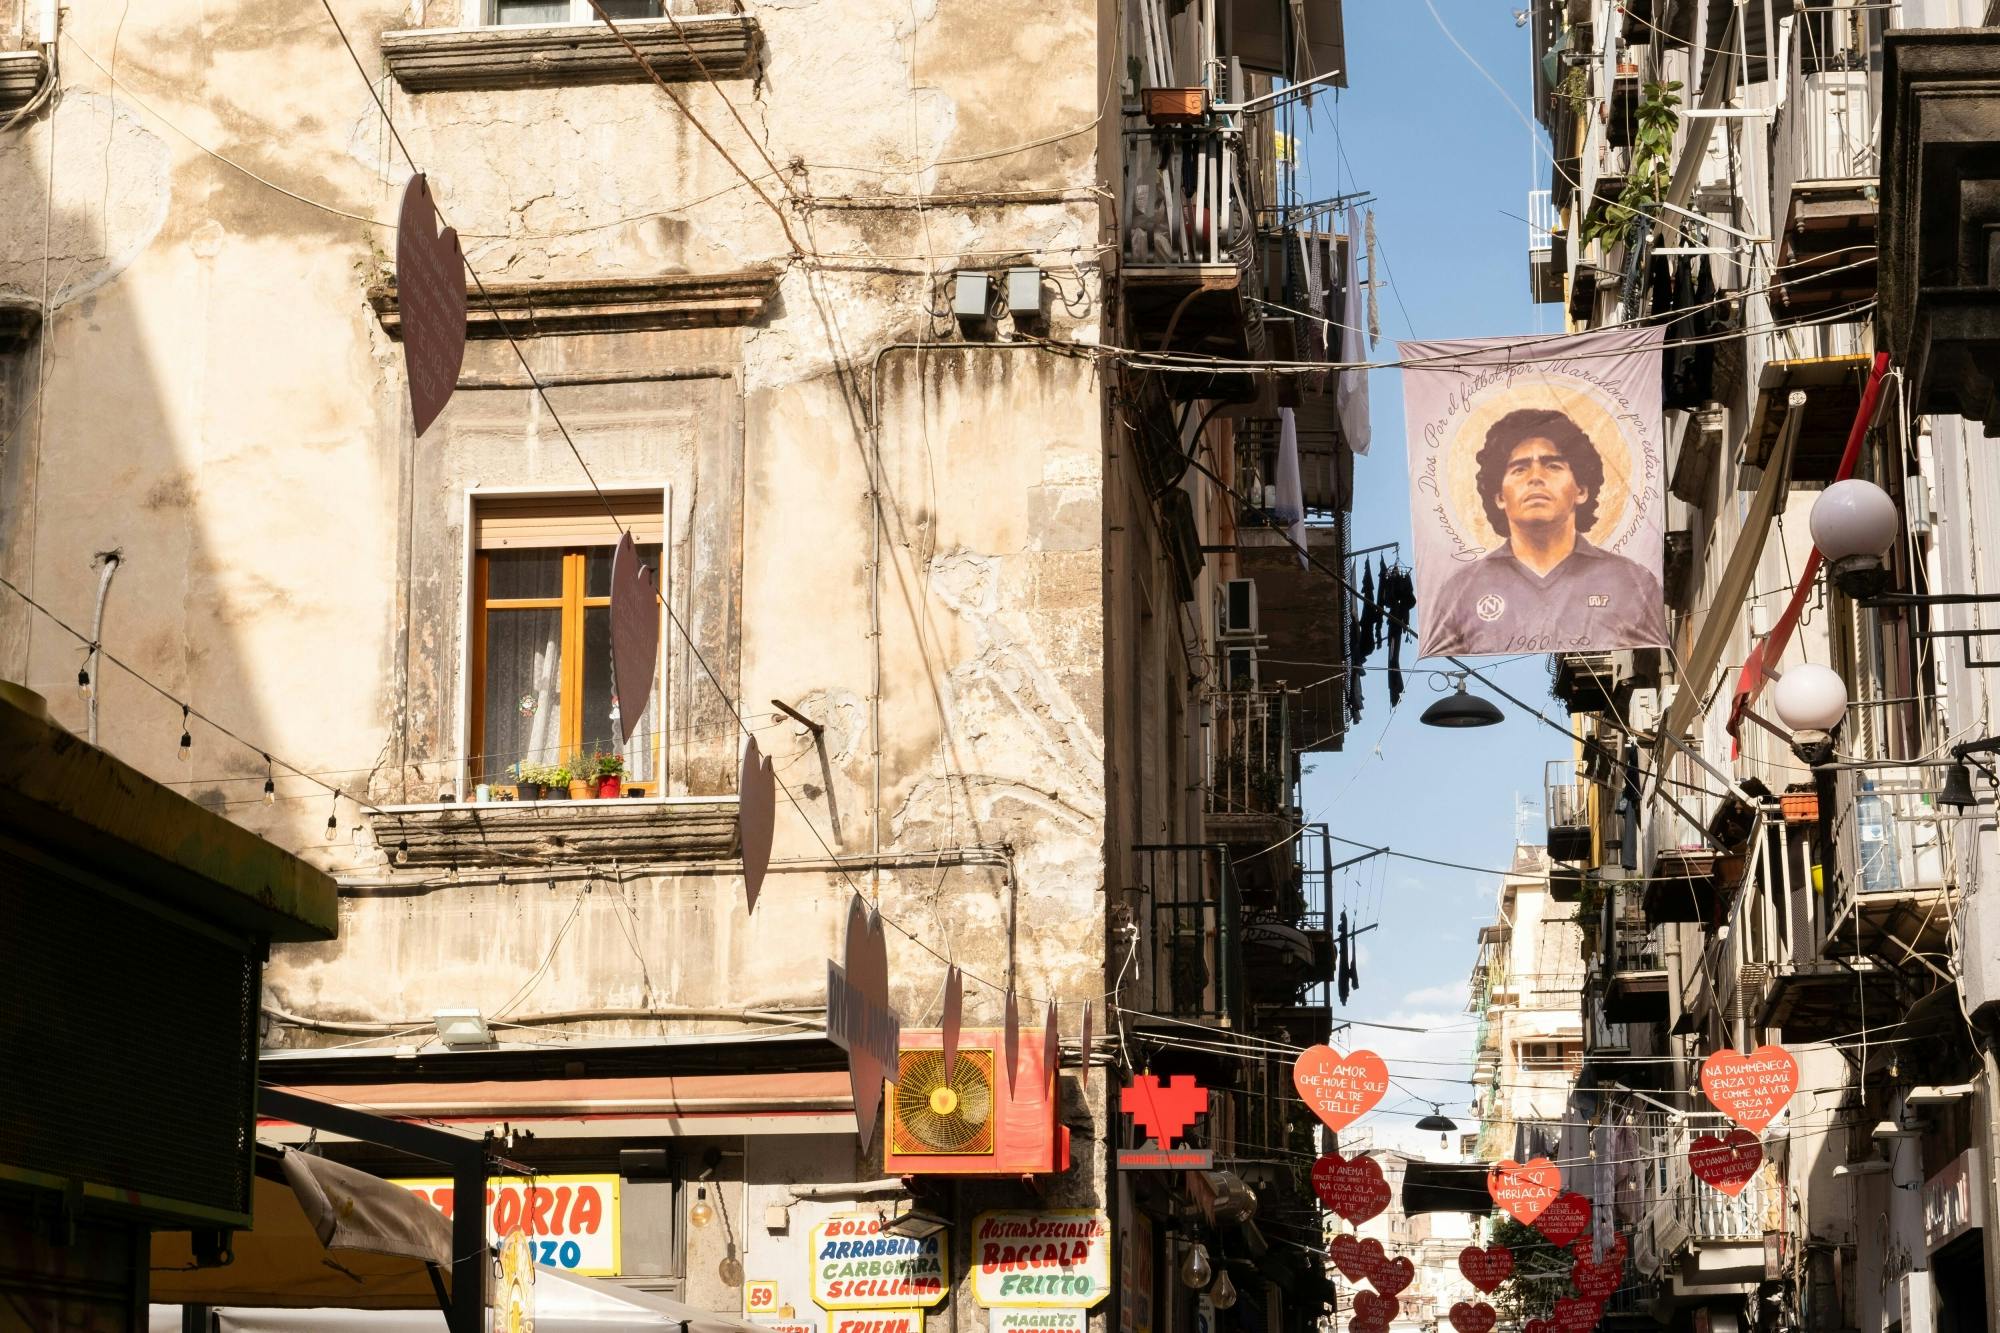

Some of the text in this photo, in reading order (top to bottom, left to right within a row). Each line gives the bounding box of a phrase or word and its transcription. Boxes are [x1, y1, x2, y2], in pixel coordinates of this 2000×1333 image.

[1448, 392, 1459, 415] el
[1617, 413, 1648, 435] por
[1425, 418, 1448, 448] Por
[1418, 456, 1440, 498] Dios
[1505, 635, 1550, 651] 1960
[1705, 1065, 1722, 1077] NA
[1300, 1075, 1320, 1085] CHE
[1323, 1078, 1347, 1088] MOVE
[1362, 1081, 1385, 1092] SOLE
[1710, 1078, 1745, 1090] SENZA
[1316, 1088, 1323, 1098] E
[1723, 1088, 1752, 1099] COMME
[1754, 1086, 1768, 1096] NA
[1771, 1084, 1790, 1094] VITA
[1319, 1100, 1360, 1114] STELLE
[1733, 1098, 1763, 1109] SENZA
[1738, 1108, 1771, 1120] PIZZA
[1706, 1155, 1730, 1166] DANNO
[1504, 1172, 1523, 1186] ME
[1333, 1184, 1352, 1192] COSA
[1526, 1202, 1540, 1212] TE
[824, 1220, 880, 1236] BOLO
[819, 1237, 939, 1260] ARRABBIATA
[822, 1257, 942, 1280] CARBONARA
[826, 1276, 942, 1298] SICILIANA
[999, 1274, 1094, 1297] FRITTO
[751, 1288, 773, 1307] 59
[1002, 1314, 1077, 1327] MAGNETS
